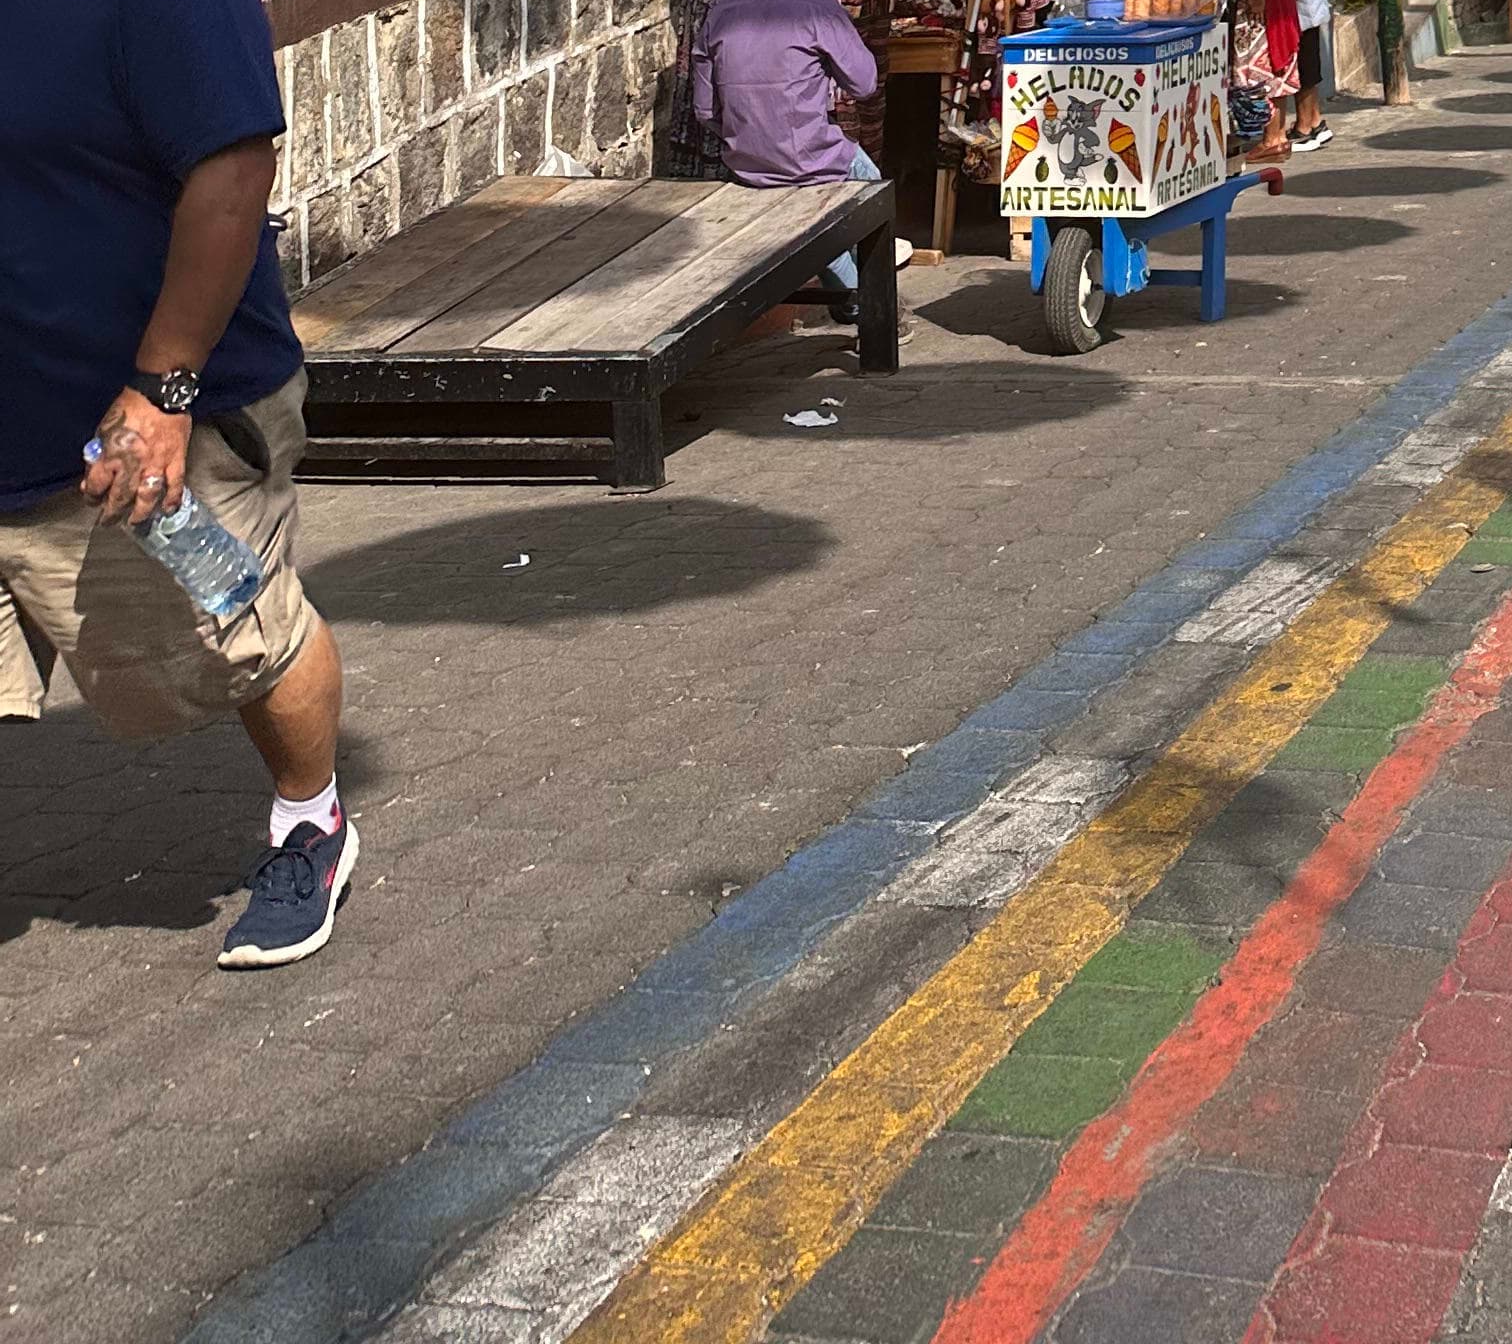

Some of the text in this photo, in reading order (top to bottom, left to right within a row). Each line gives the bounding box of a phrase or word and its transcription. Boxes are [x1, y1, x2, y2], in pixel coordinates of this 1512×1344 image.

[1023, 47, 1129, 62] DELICIOSOS
[1162, 47, 1219, 91] HELADOS
[1010, 66, 1141, 115] HELADOS
[1001, 186, 1147, 212] ARTESANAL
[1156, 159, 1219, 207] ARTESANAL
